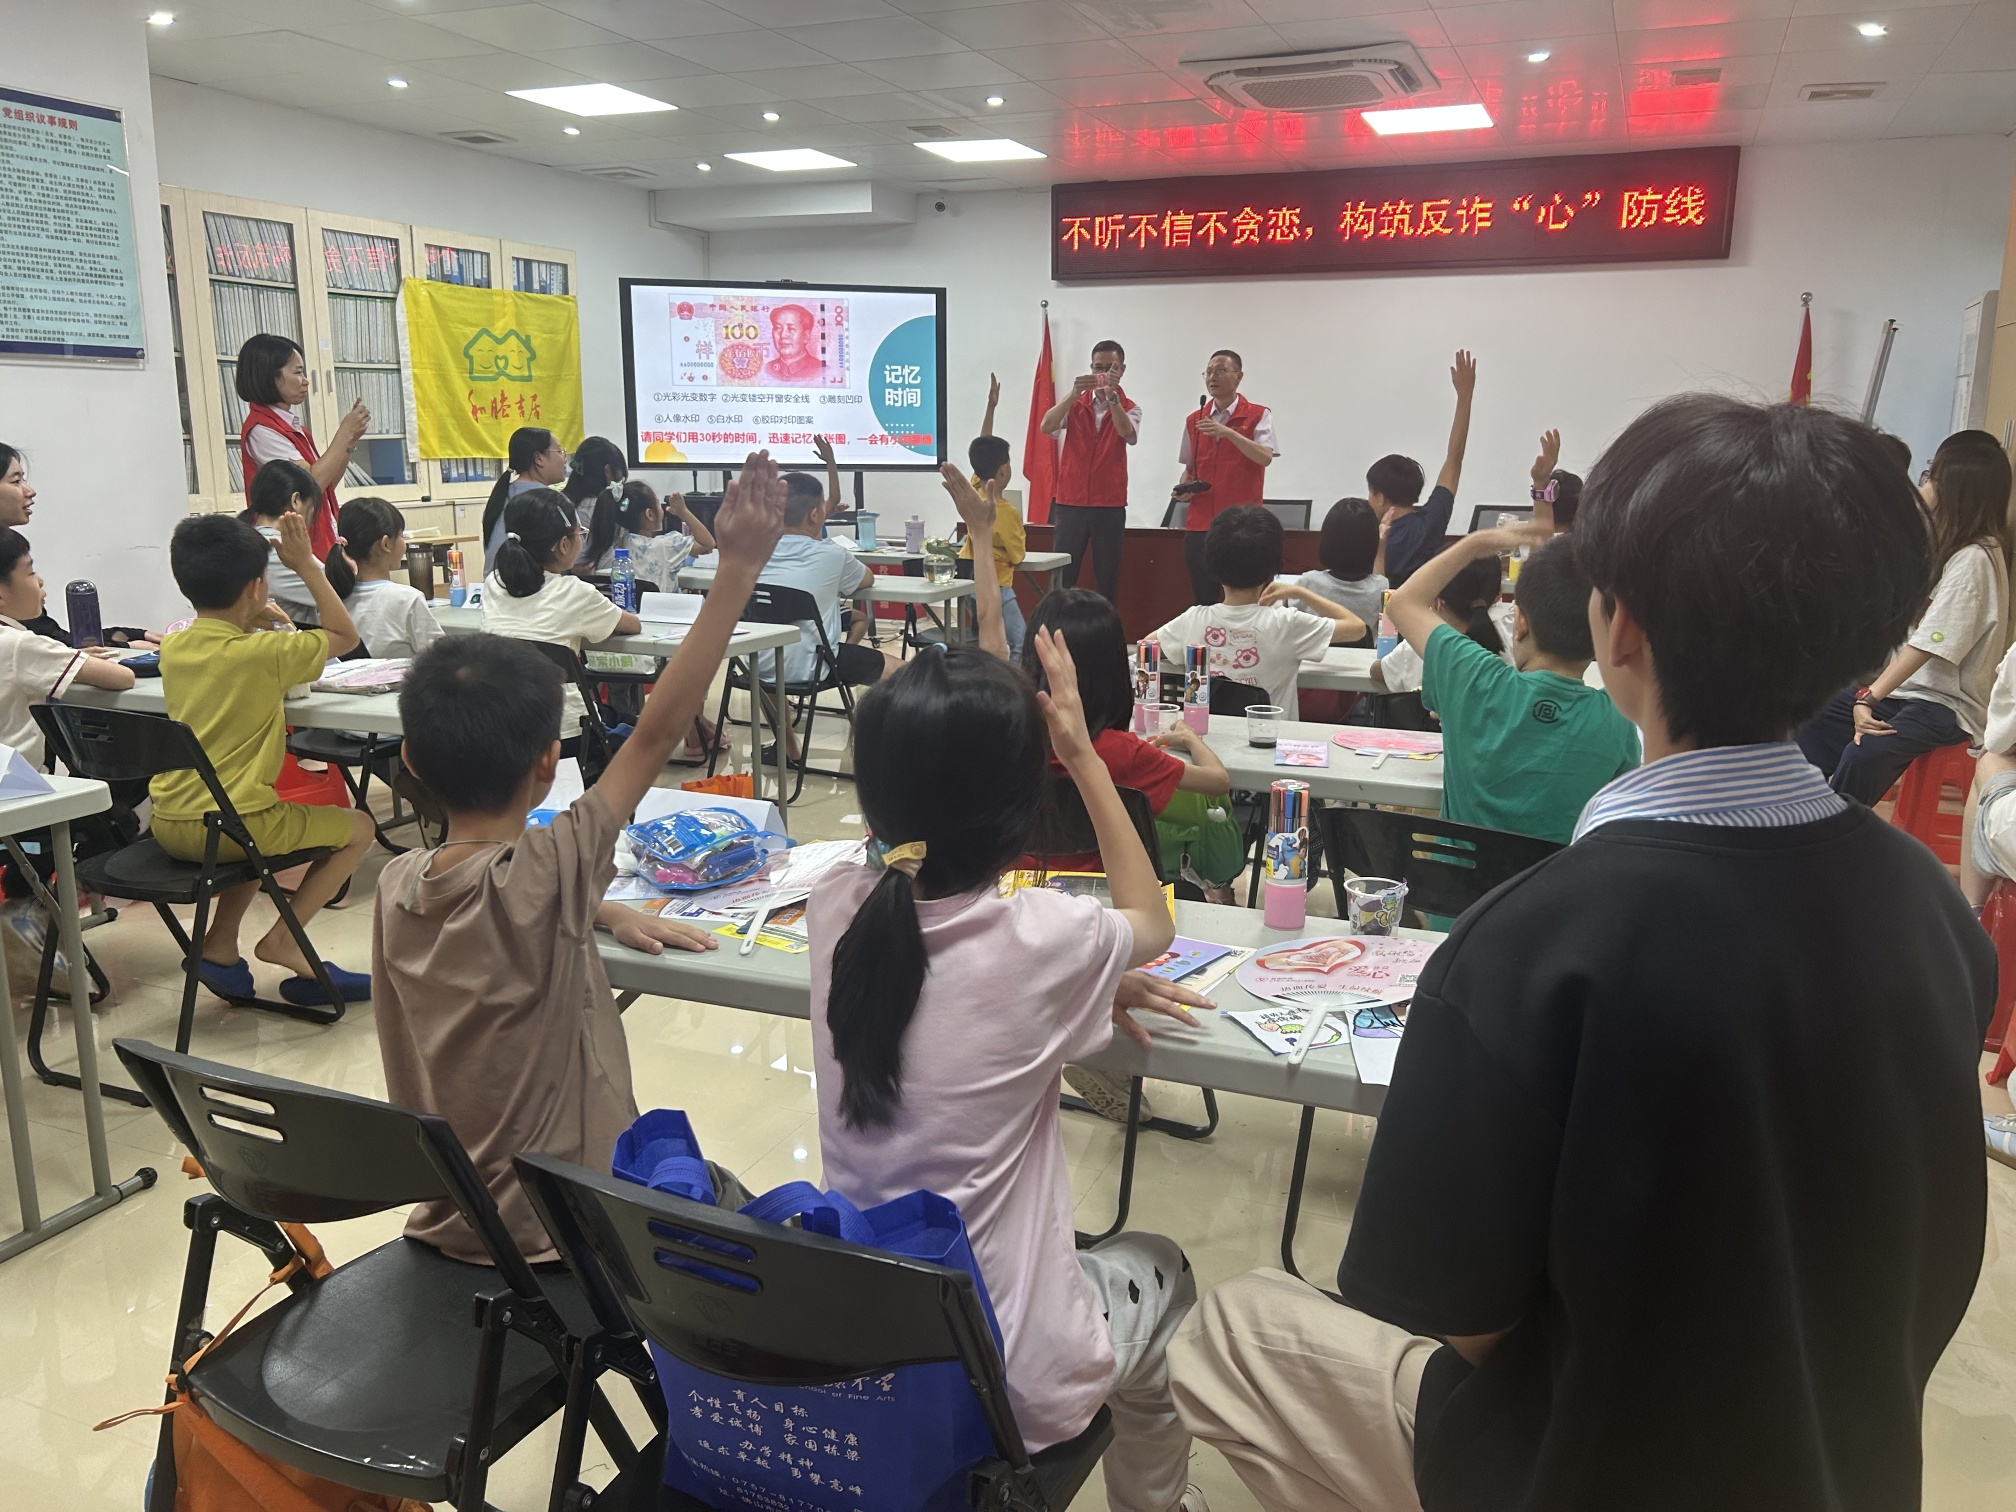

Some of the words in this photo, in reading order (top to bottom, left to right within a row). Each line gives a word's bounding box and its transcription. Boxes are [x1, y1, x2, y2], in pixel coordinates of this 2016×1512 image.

[2, 106, 78, 131] 党组织议事规则
[723, 324, 759, 340] 100
[884, 364, 921, 385] 记忆
[884, 387, 921, 408] 时间
[732, 1388, 809, 1418] 育人目标
[848, 1393, 870, 1401] Fine
[688, 1390, 761, 1421] 个性飞扬
[783, 1418, 859, 1447] 身心健康
[739, 1440, 813, 1470] 办学精神
